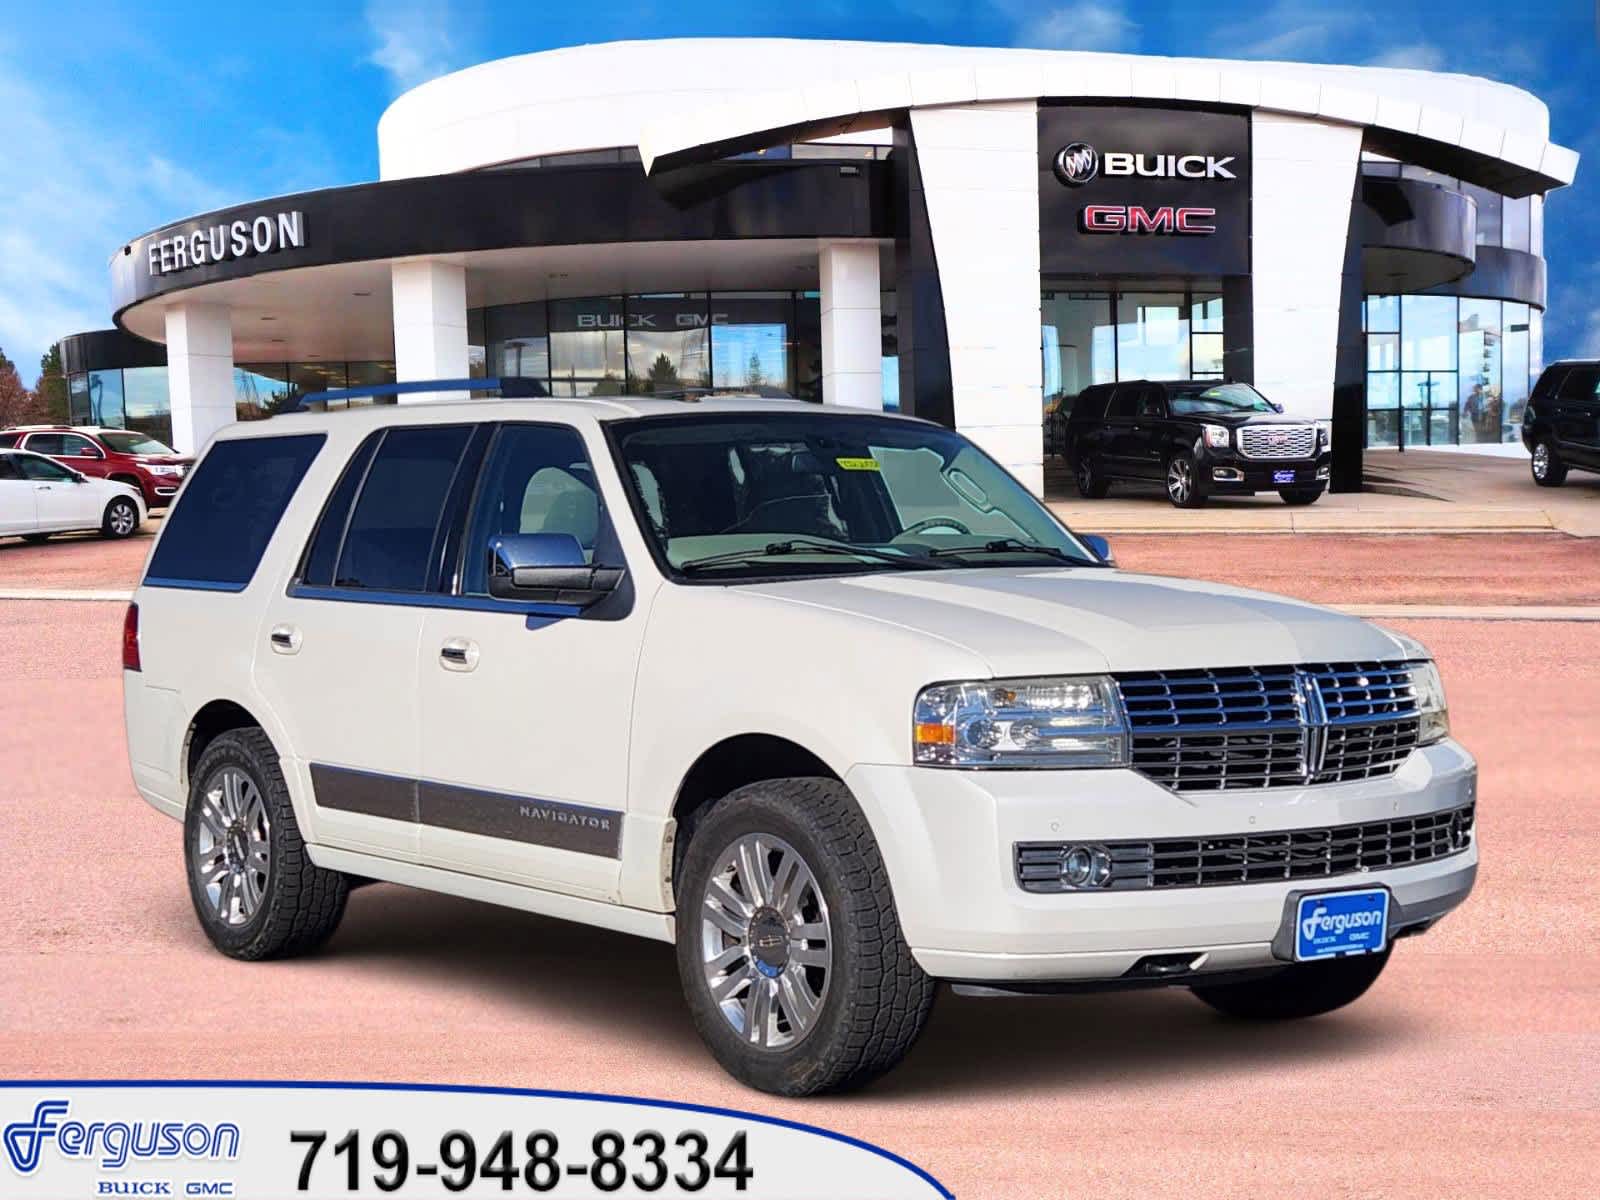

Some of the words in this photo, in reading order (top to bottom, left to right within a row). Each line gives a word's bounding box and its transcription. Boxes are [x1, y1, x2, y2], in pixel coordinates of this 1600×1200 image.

[1104, 152, 1237, 179] BUICK
[1085, 205, 1216, 233] GMC
[149, 210, 303, 276] FERGUSON
[520, 805, 611, 832] NAVIGATOR
[1302, 906, 1383, 941] Ferguson
